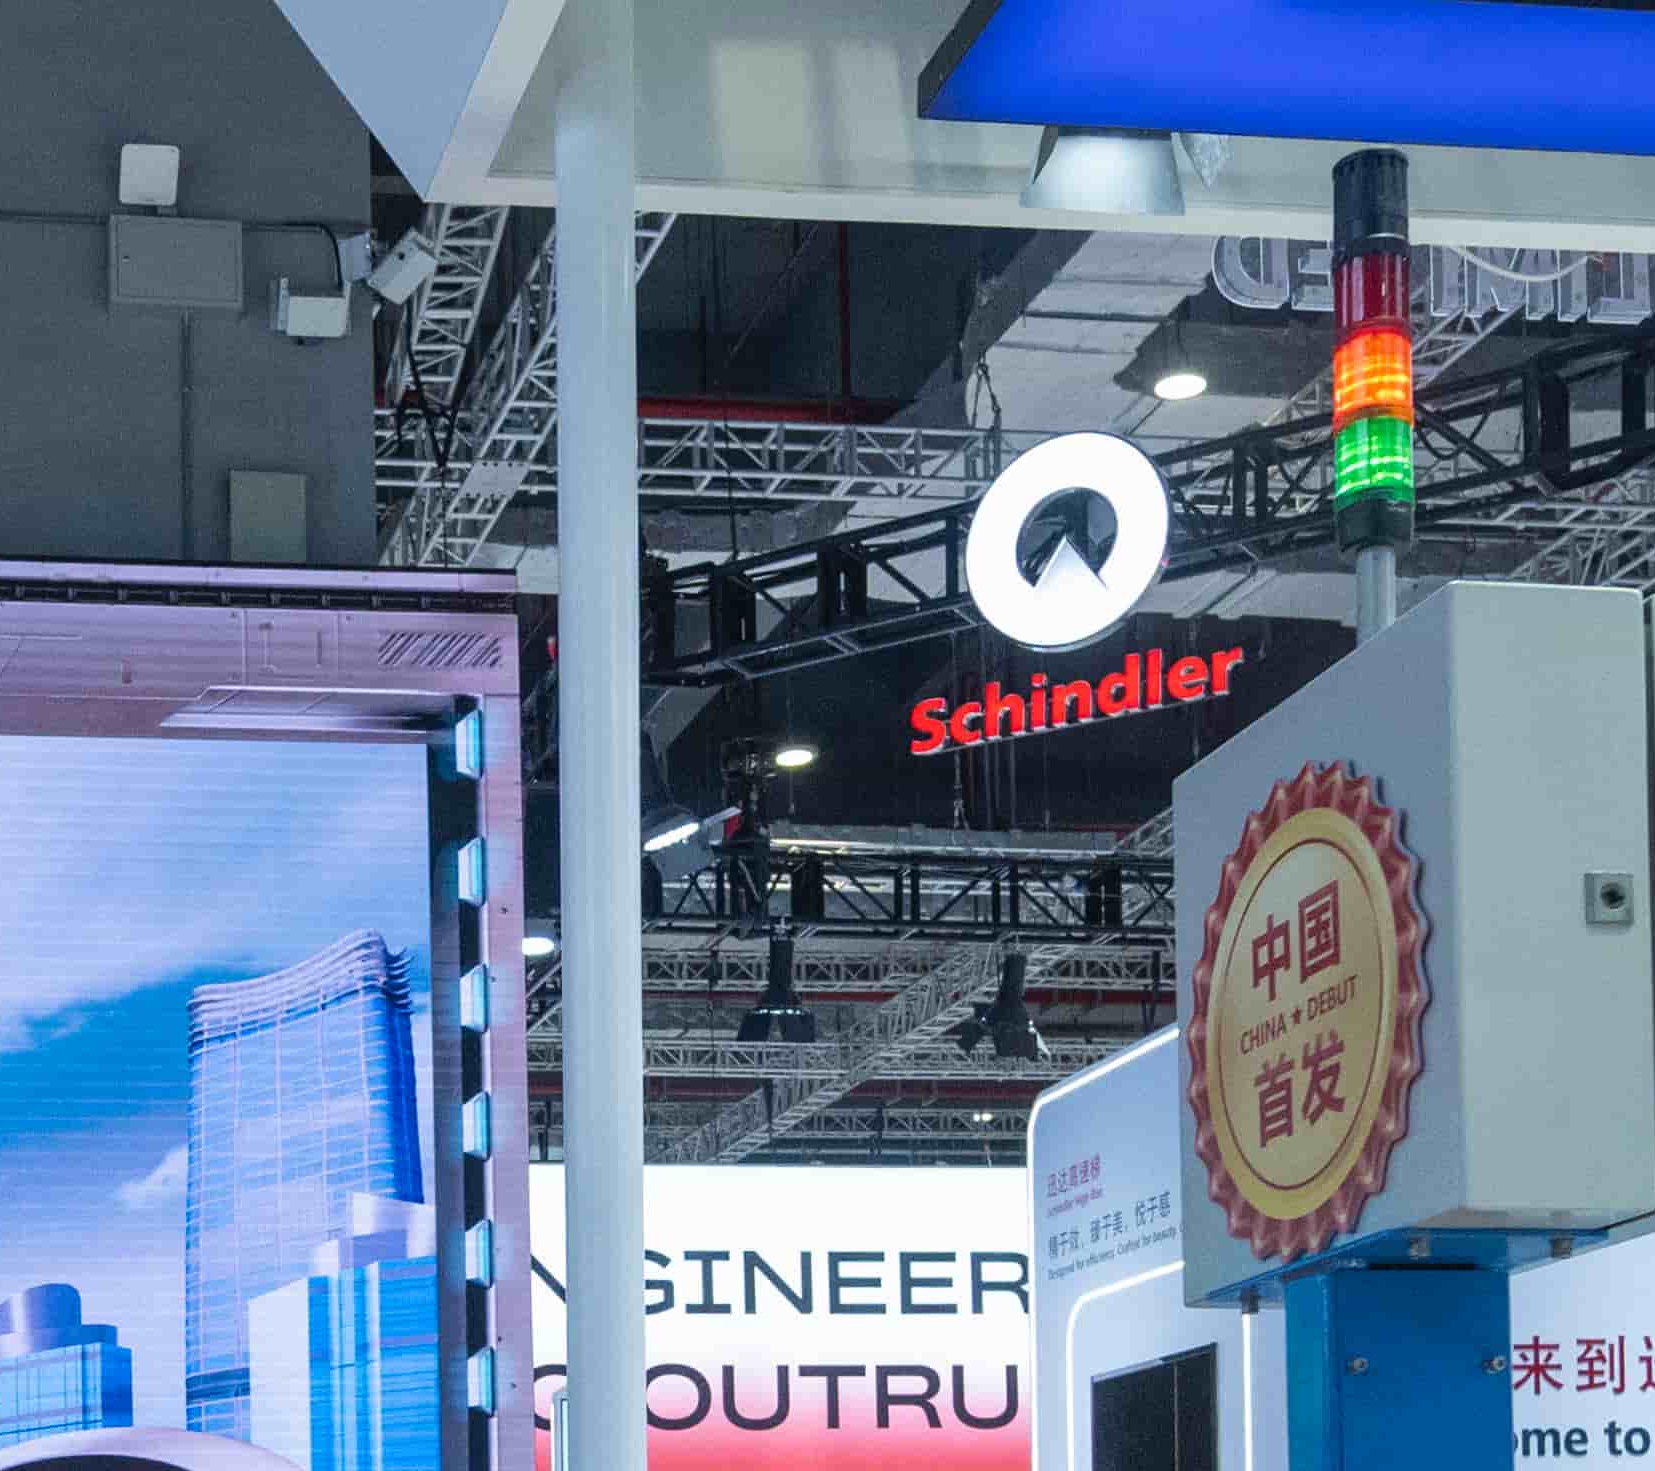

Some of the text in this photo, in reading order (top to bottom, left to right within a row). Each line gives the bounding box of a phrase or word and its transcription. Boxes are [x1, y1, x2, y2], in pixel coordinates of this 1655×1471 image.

[909, 645, 1244, 756] Schindler
[1251, 879, 1341, 1002] 中国
[1238, 974, 1358, 1055] CHINA DEBUT
[1255, 1027, 1347, 1148] 首发
[531, 1249, 1030, 1316] GINEER
[1514, 1422, 1590, 1457] me
[1603, 1419, 1651, 1457] to
